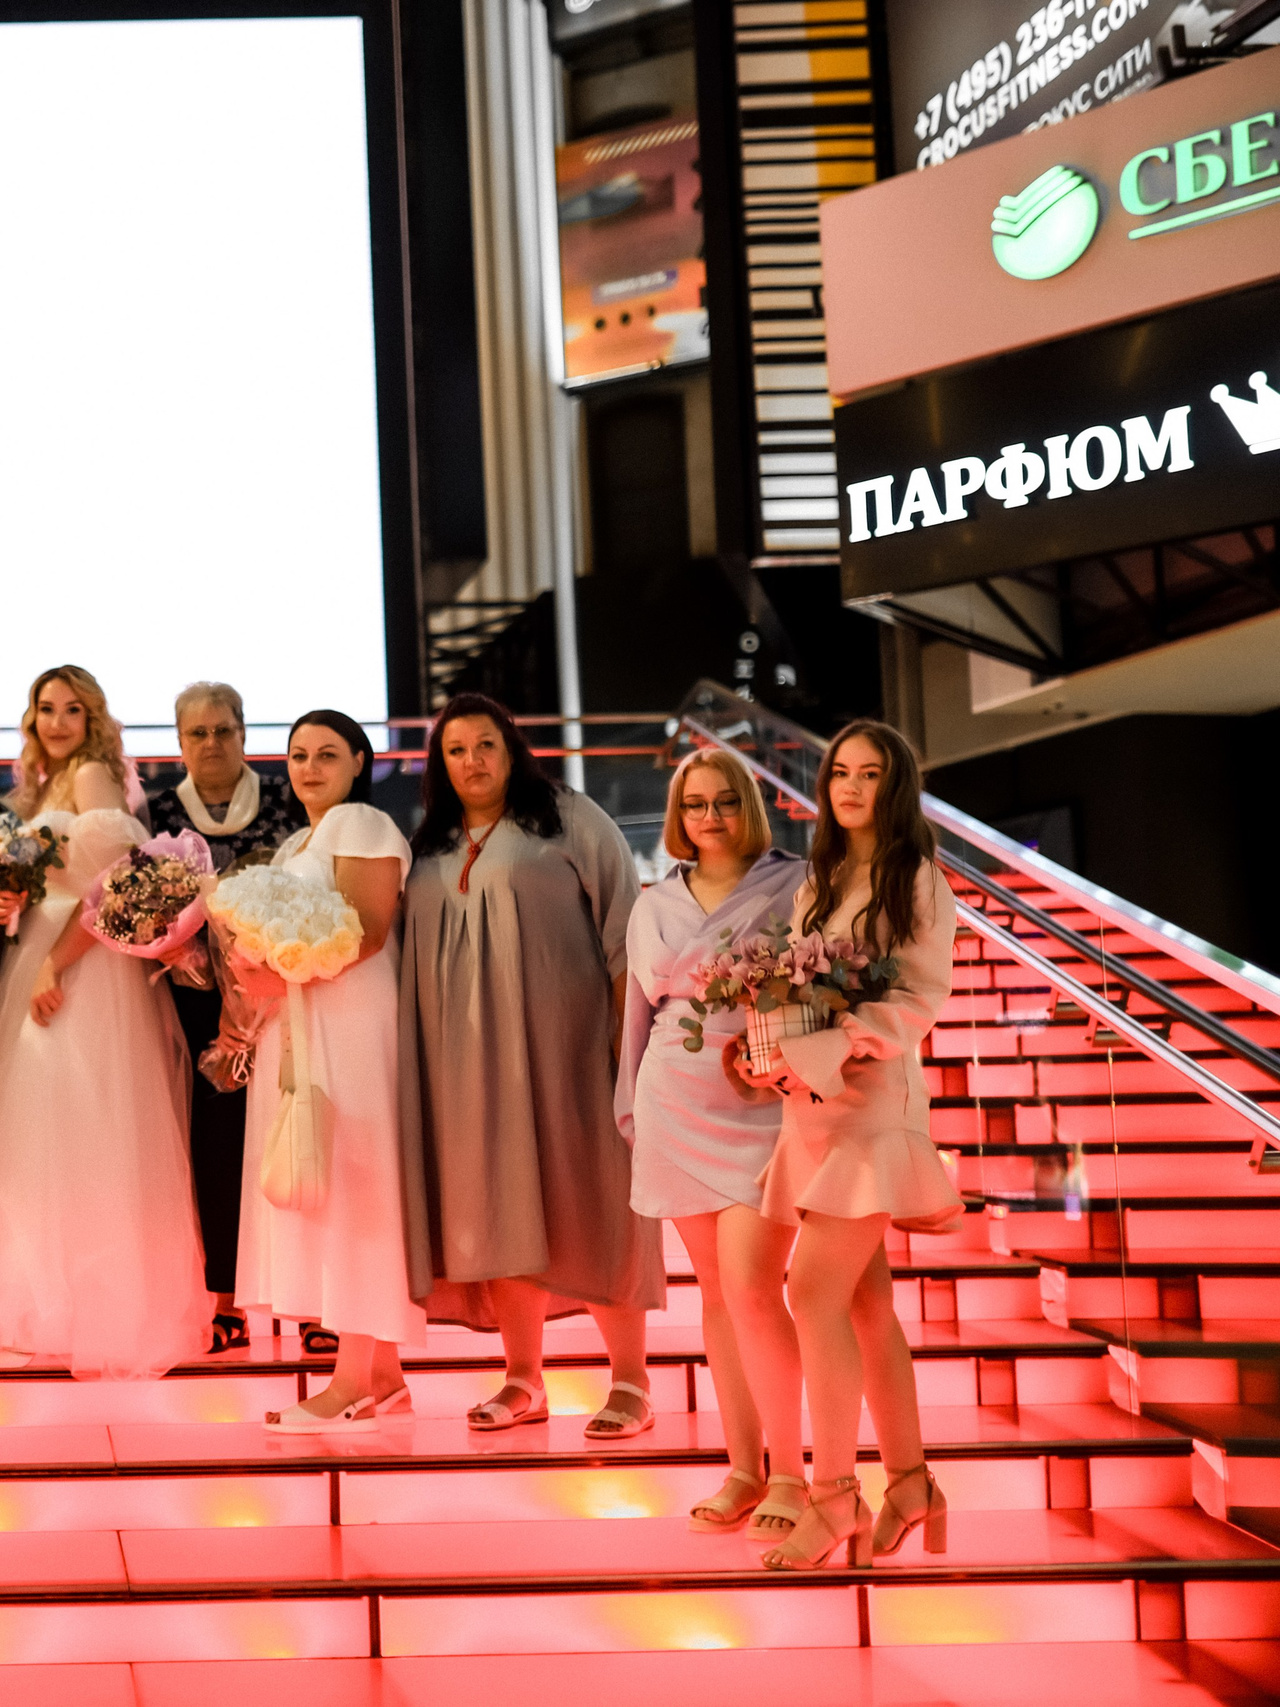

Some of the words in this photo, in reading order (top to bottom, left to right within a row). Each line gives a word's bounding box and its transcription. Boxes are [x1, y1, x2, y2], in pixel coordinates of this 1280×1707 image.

[914, 92, 943, 140] +7
[946, 40, 1012, 123] (495)
[1093, 36, 1153, 99] СИТИ
[846, 404, 1195, 543] ПАРФЮМ
